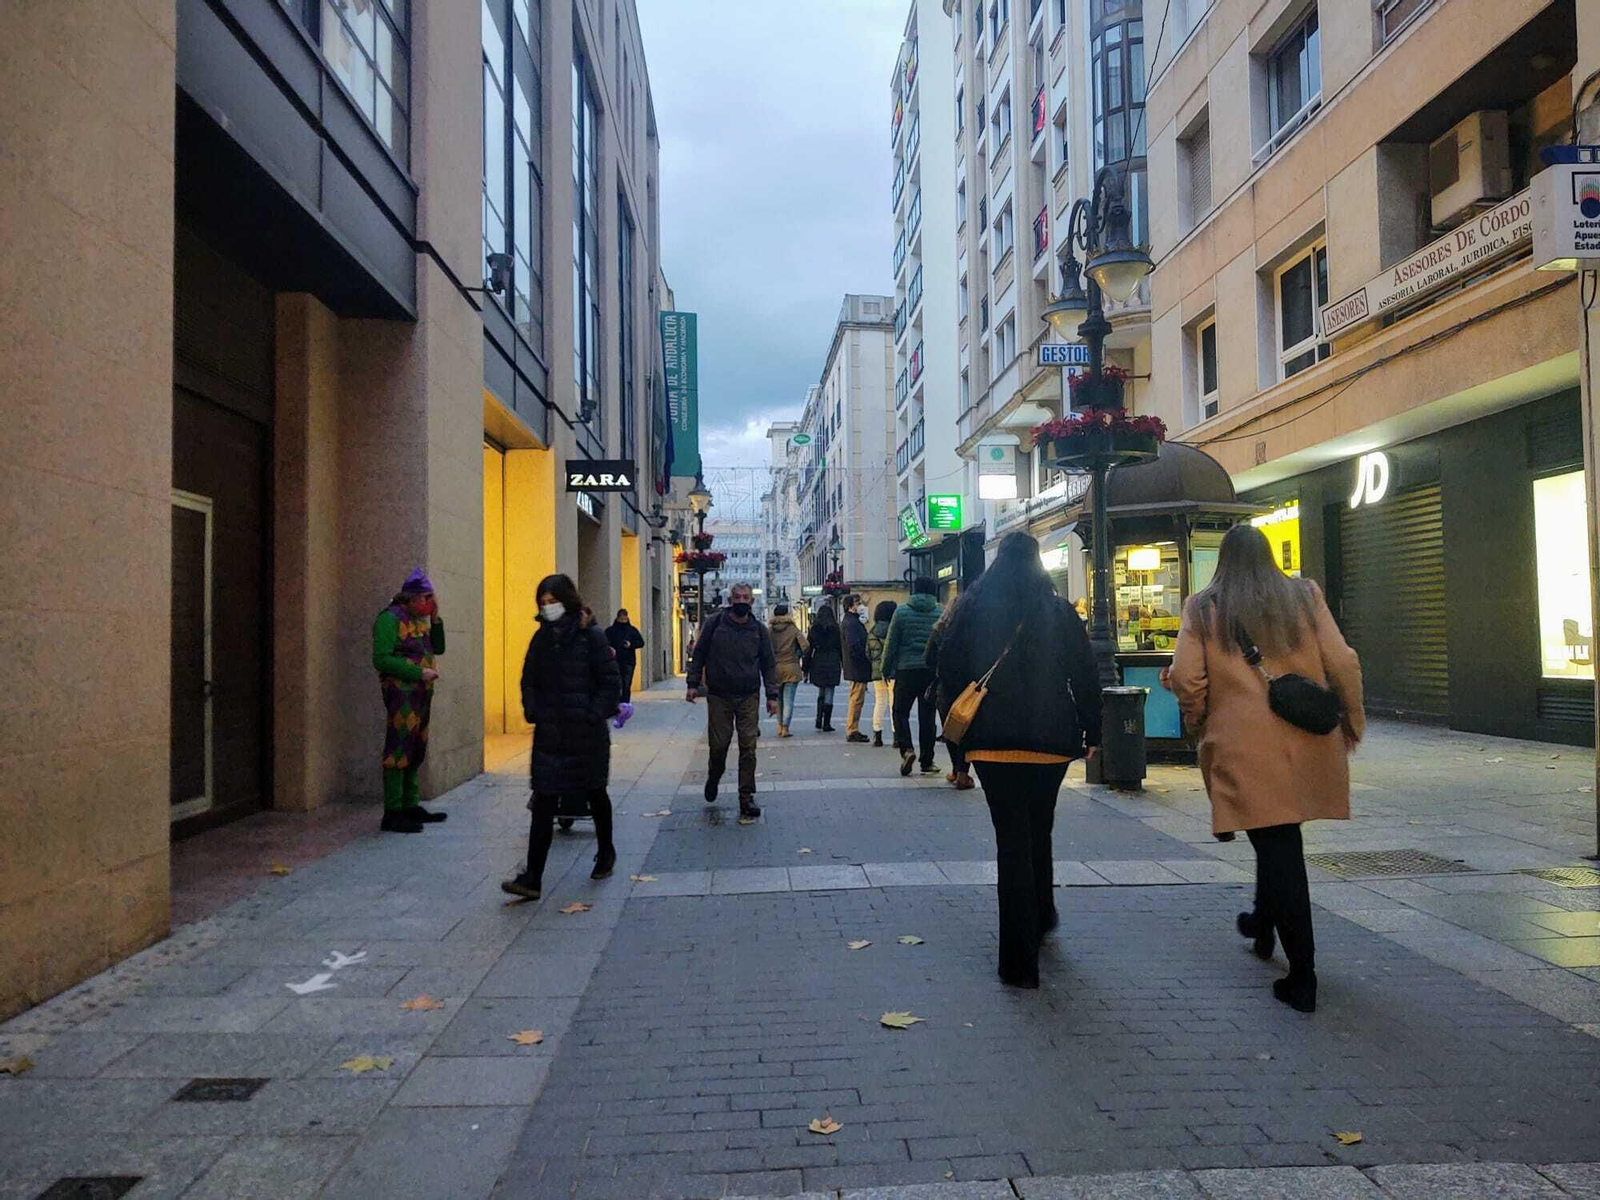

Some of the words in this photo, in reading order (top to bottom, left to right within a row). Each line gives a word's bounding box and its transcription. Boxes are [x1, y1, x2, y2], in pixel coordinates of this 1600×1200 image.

[1394, 243, 1452, 287] ASESORES
[1455, 229, 1476, 252] DE
[1480, 197, 1531, 237] CÓRDO
[1378, 284, 1415, 310] ASESORIA
[1417, 262, 1459, 290] LABORAL,
[1461, 237, 1509, 266] JURIDICA,
[1327, 295, 1366, 331] ASESORES
[1042, 346, 1090, 362] GESTOR
[668, 373, 678, 386] DE
[570, 474, 631, 486] ZARA
[1350, 451, 1390, 509] JD
